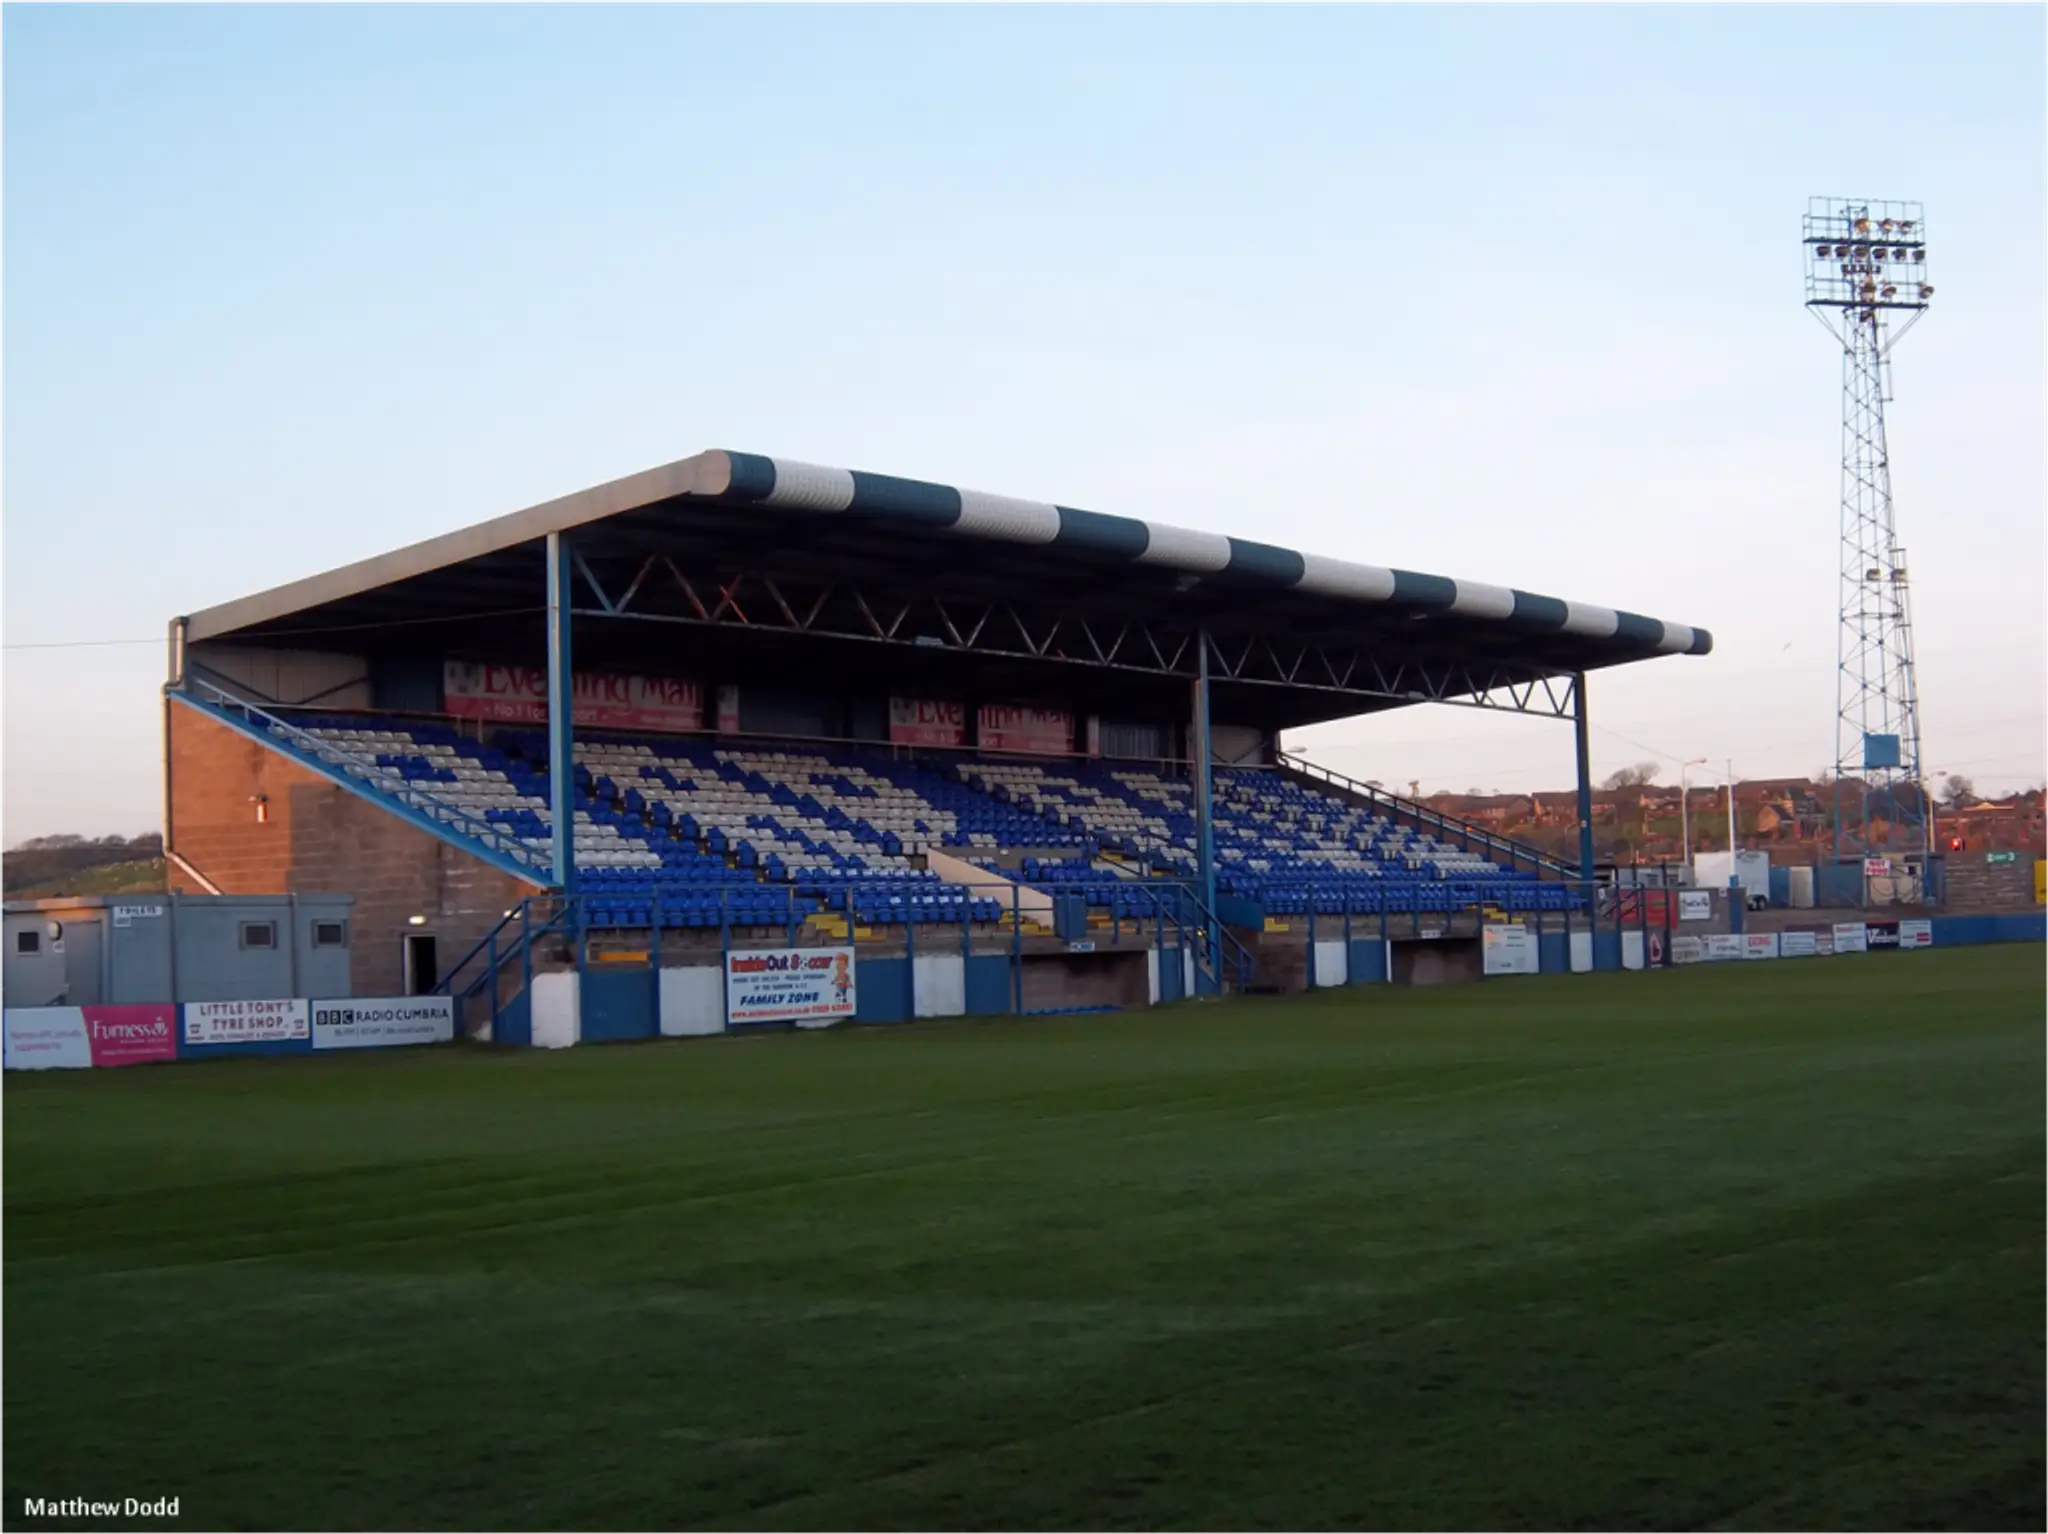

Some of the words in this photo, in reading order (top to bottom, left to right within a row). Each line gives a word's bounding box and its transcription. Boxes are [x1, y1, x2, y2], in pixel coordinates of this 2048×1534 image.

[484, 663, 633, 712] Eveing
[740, 993, 786, 1006] FAMILY
[786, 991, 820, 1004] ZONE
[199, 1002, 245, 1016] LITTLE
[247, 1000, 294, 1014] TONY'S
[316, 1010, 354, 1025] BBC
[355, 1009, 394, 1022] RADIO
[395, 1007, 450, 1021] CUMBRIA
[212, 1017, 245, 1031] TYRE
[248, 1015, 284, 1029] SHOP
